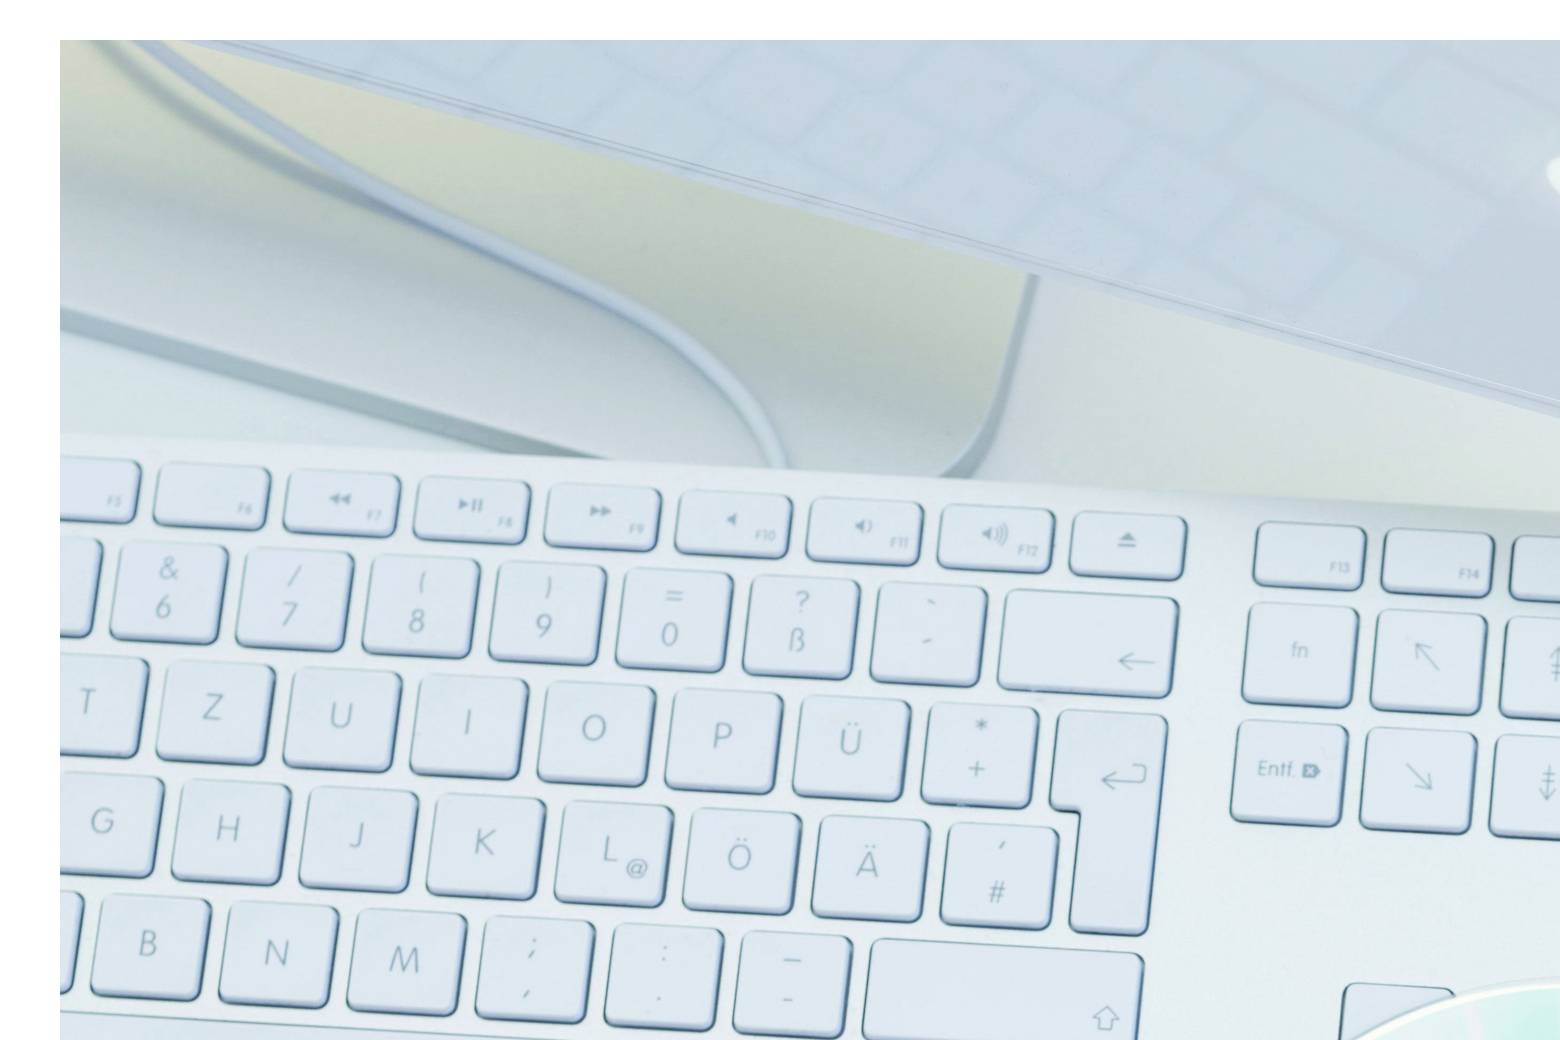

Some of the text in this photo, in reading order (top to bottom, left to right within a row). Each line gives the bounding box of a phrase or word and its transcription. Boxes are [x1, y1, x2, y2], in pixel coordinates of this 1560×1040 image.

[365, 508, 383, 522] F7
[627, 522, 646, 535] F9
[754, 528, 778, 543] F10
[889, 535, 910, 550] F11
[1016, 543, 1040, 558] F12
[158, 555, 179, 581] &
[286, 563, 303, 588] /
[1328, 560, 1352, 575] F13
[1458, 567, 1481, 580] F14
[154, 593, 172, 620] 6
[281, 600, 300, 628] 7
[795, 589, 811, 614] ?
[407, 607, 426, 635] 8
[535, 612, 554, 639] 9
[660, 620, 680, 648] 0
[787, 626, 806, 653] ß
[1290, 640, 1310, 659] fn
[79, 686, 97, 715] T
[201, 691, 225, 722] Z
[329, 700, 354, 730] U
[463, 708, 473, 736] I
[581, 713, 608, 743] O
[712, 721, 734, 750] P
[839, 721, 863, 757] Ü
[967, 760, 986, 778] +
[89, 806, 115, 835] G
[215, 814, 241, 843] H
[348, 821, 365, 850] J
[474, 827, 497, 856] K
[602, 834, 618, 863] L
[625, 857, 649, 879] @
[726, 836, 753, 872] Ö
[855, 844, 879, 879] Ä
[988, 880, 1006, 904] #
[138, 928, 158, 958] B
[263, 938, 290, 967] N
[388, 944, 420, 974] M
